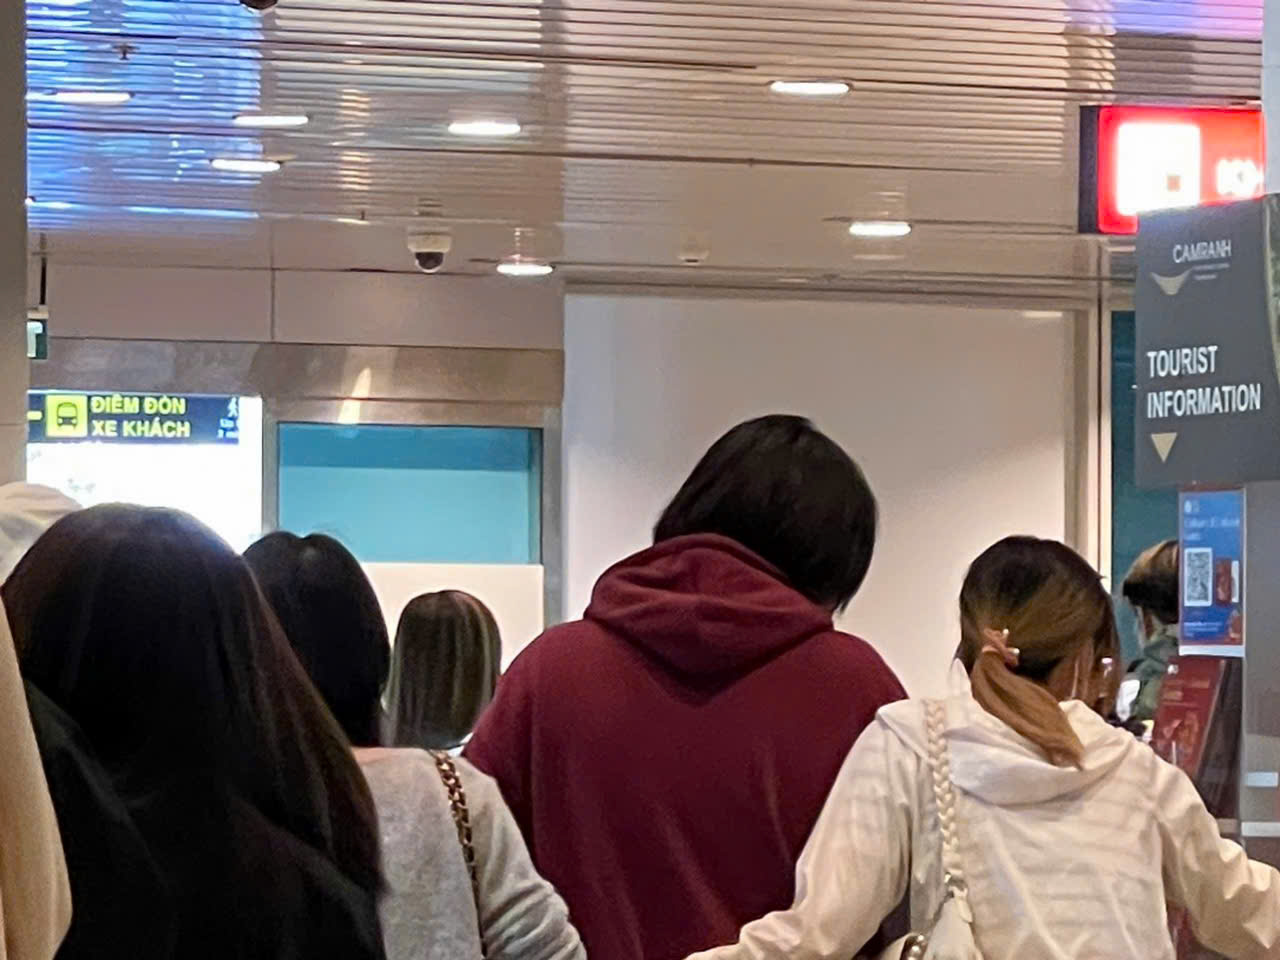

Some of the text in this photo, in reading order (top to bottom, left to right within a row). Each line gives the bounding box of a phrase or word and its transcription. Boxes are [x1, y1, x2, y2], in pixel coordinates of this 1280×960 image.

[1147, 345, 1218, 378] TOURIST
[1147, 383, 1262, 419] INFORMATION
[91, 416, 191, 438] XE KHÁCH
